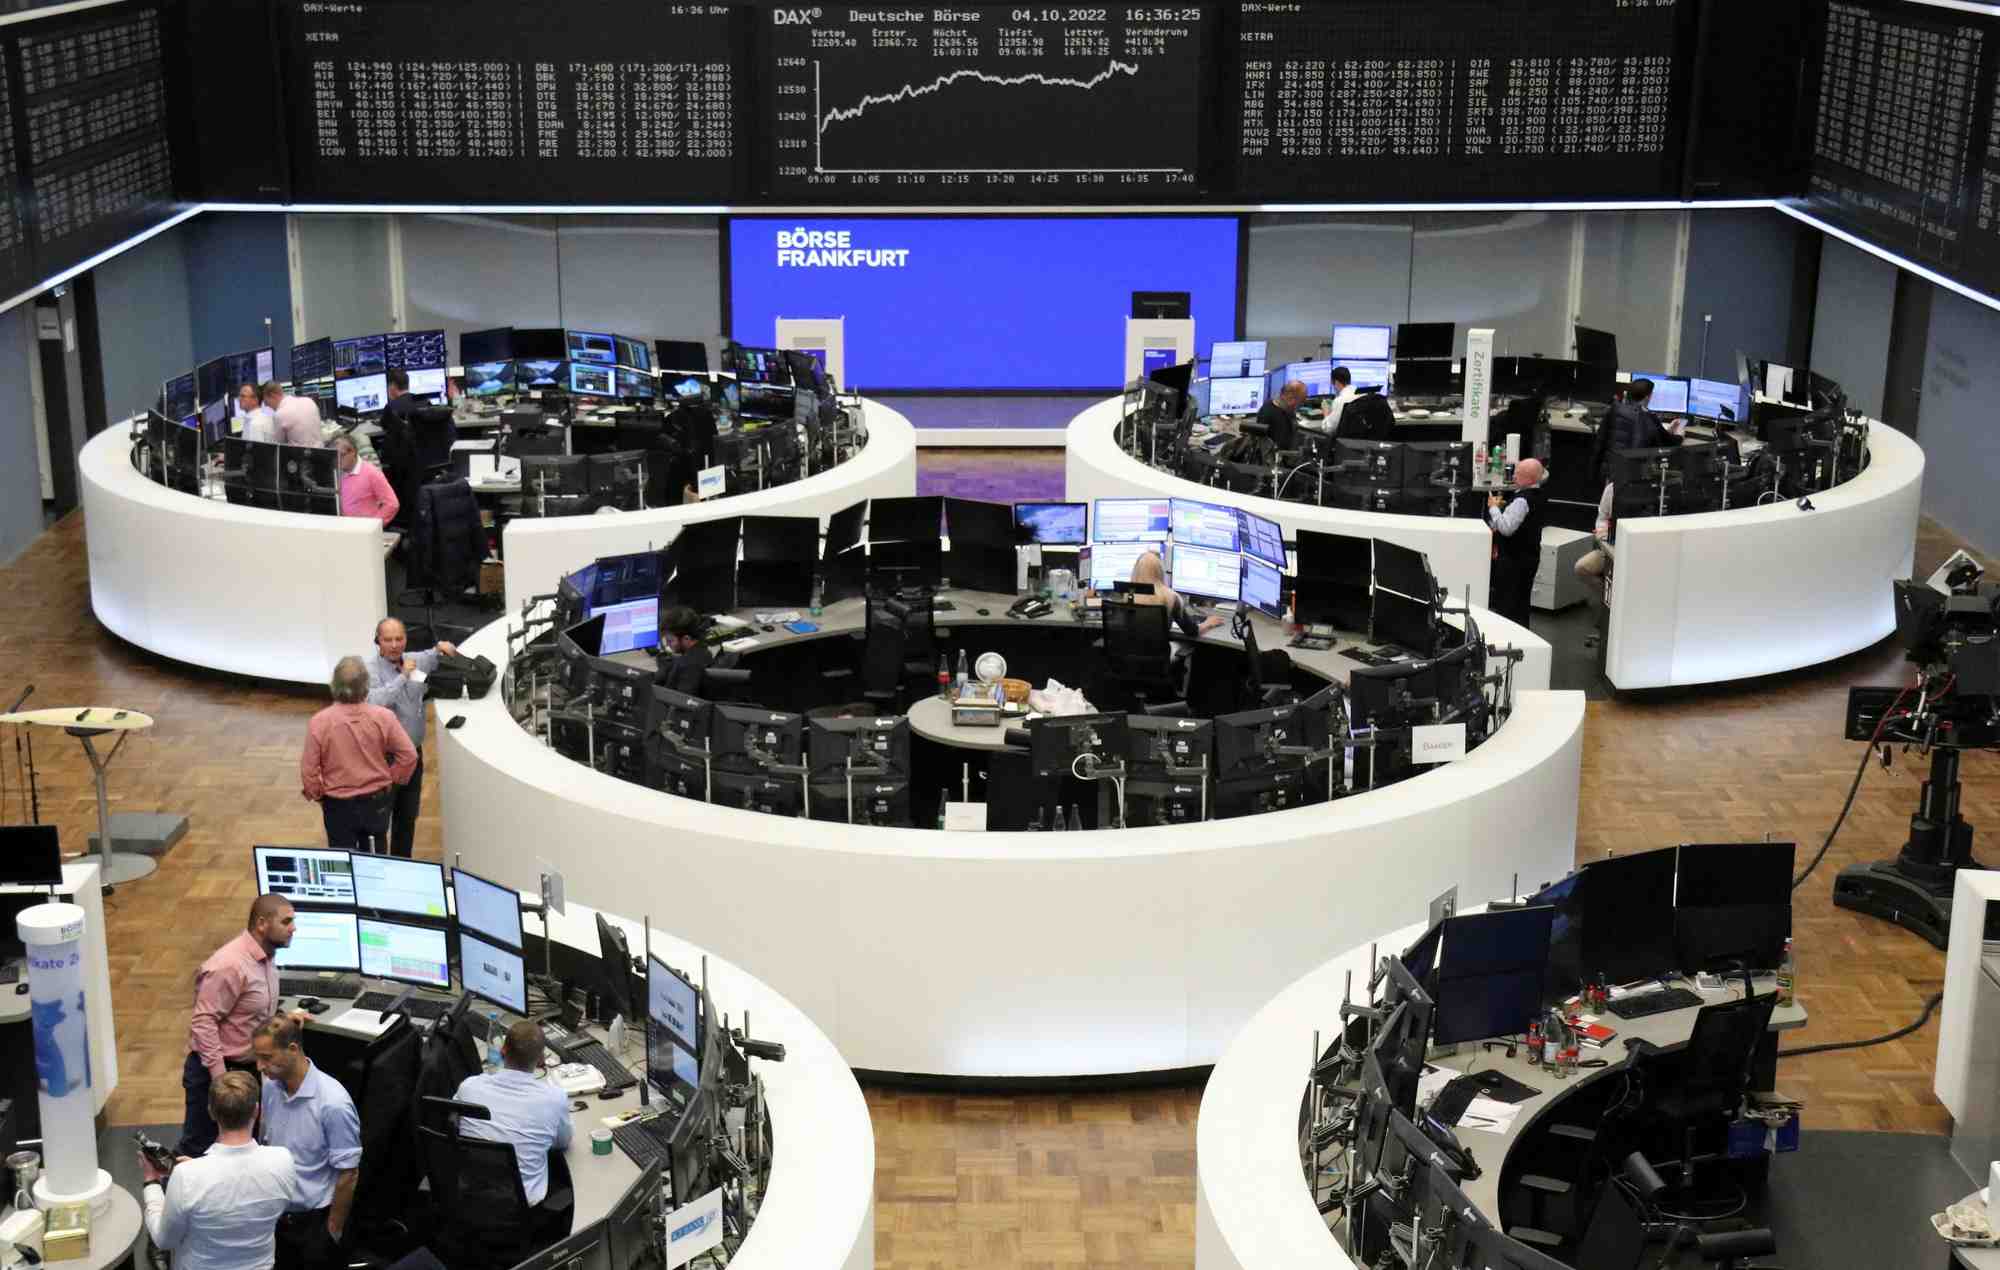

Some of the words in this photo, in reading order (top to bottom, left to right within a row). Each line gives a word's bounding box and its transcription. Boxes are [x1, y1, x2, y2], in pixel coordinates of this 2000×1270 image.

[304, 4, 362, 12] DAX-Werte
[710, 6, 729, 14] Uhr
[1242, 4, 1301, 12] DAX-Werte
[849, 10, 924, 22] Deutsche
[934, 9, 980, 22] Börse
[1012, 9, 1106, 21] 04.10.2022
[1126, 9, 1200, 21] 16:36:25
[305, 32, 339, 41] XETRA
[812, 29, 845, 38] Vortag
[933, 28, 967, 37] Höchst
[998, 28, 1032, 36] Tiefst
[1064, 28, 1104, 36] Letzter
[1125, 28, 1188, 37] Veränderung
[1240, 32, 1274, 41] XETRA
[777, 227, 851, 248] BÖRSE
[777, 250, 909, 267] FRANKFURT
